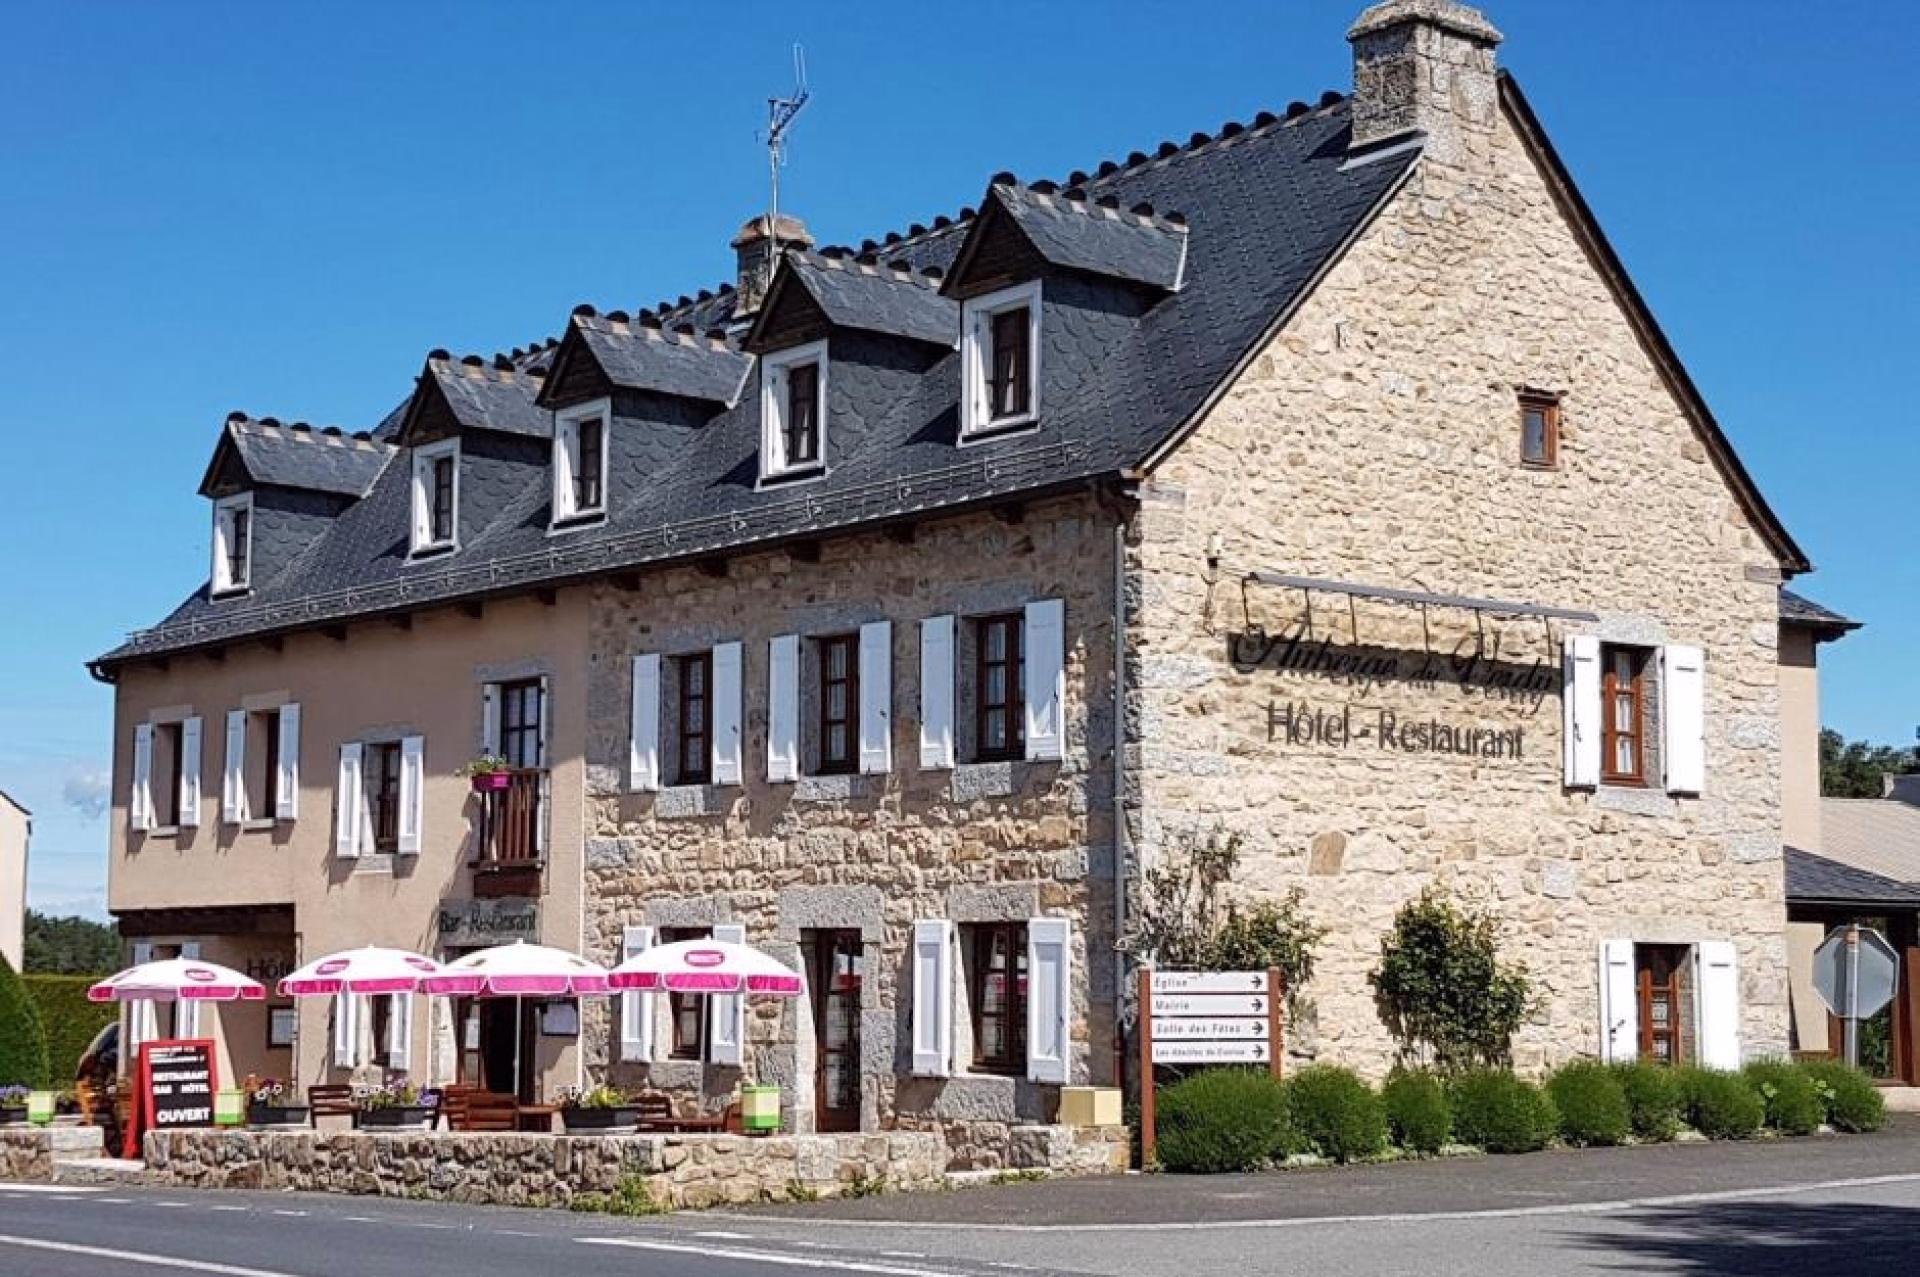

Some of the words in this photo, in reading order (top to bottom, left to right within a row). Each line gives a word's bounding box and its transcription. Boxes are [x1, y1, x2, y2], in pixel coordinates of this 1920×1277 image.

[1267, 699, 1349, 749] Hôtel
[1379, 711, 1526, 759] Restaurant
[440, 910, 461, 932] Bar
[470, 908, 536, 932] Restaurant
[1156, 1000, 1190, 1010] Mairie
[1157, 1023, 1183, 1034] Salle
[1189, 1023, 1206, 1034] des
[153, 1071, 209, 1081] RESTAURANT
[153, 1085, 172, 1095] BAR
[157, 1107, 210, 1123] OUVERT
